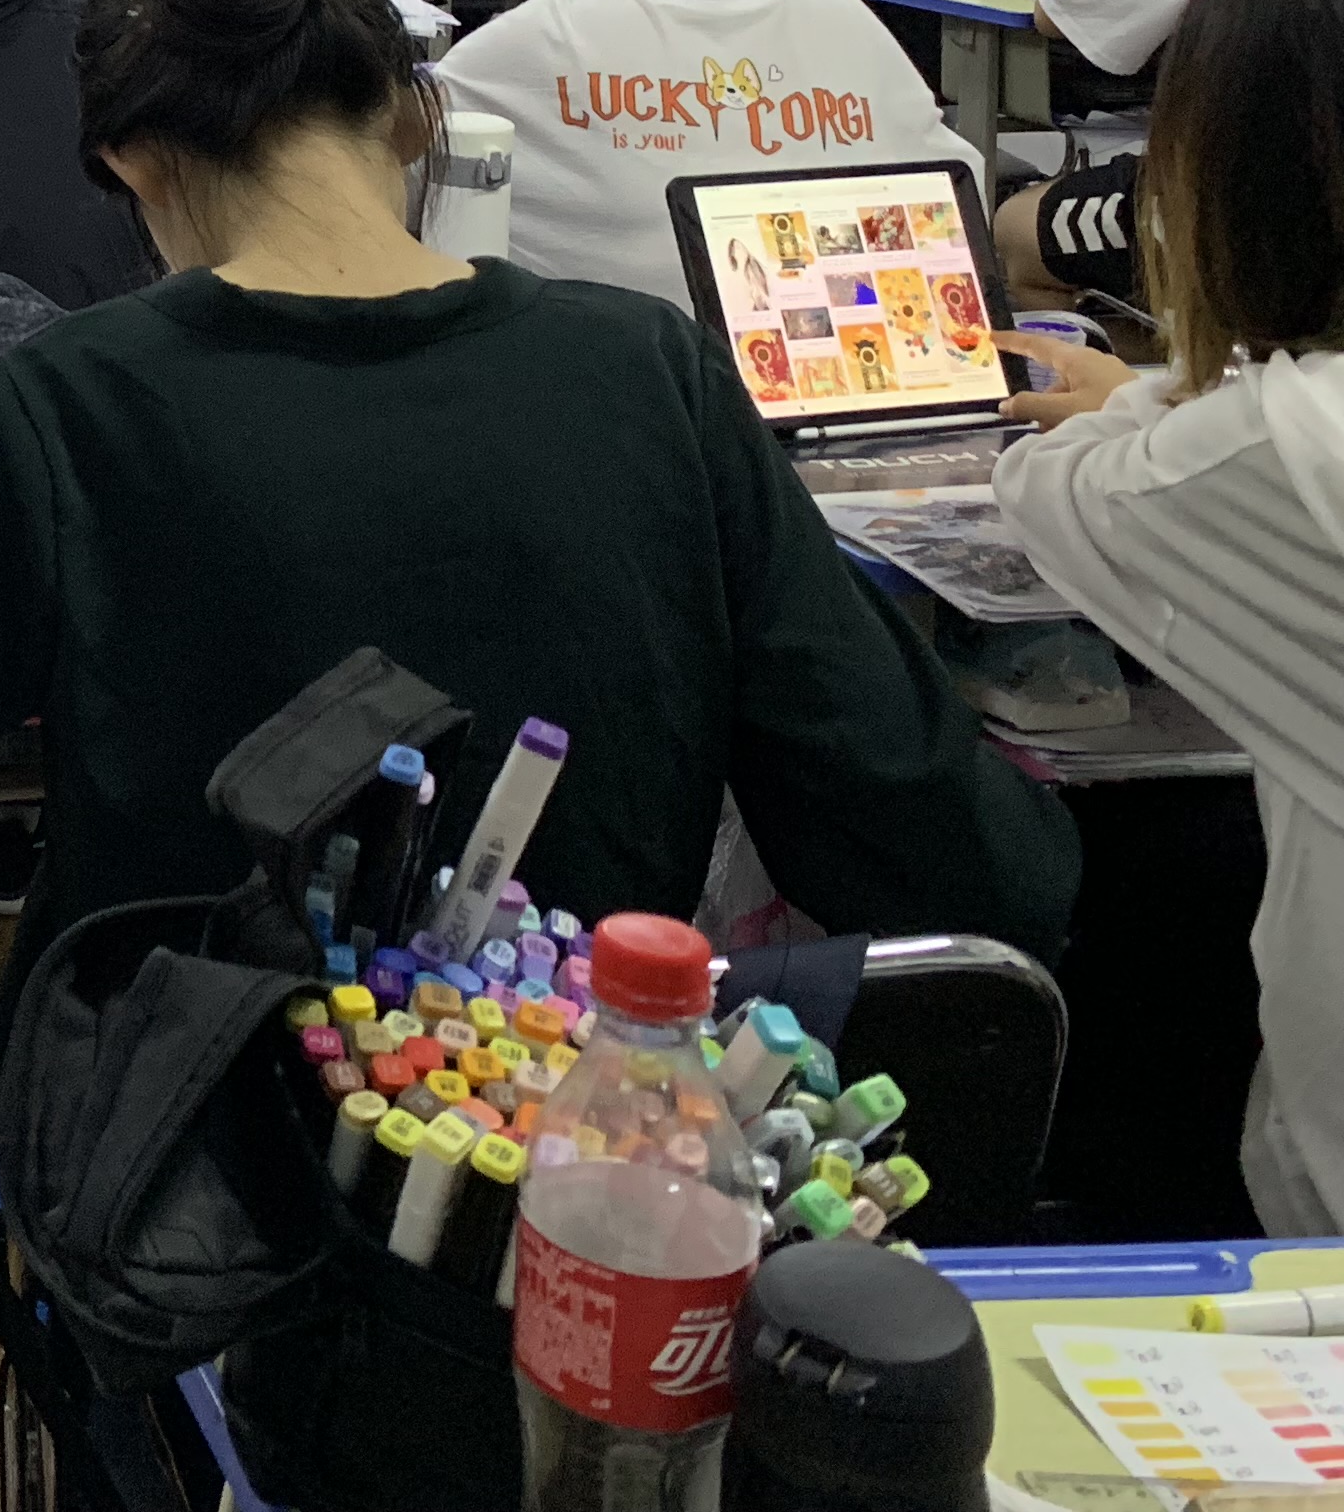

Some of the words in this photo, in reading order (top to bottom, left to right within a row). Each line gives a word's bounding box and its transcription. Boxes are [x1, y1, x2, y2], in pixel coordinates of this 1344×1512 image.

[556, 71, 726, 142] LUCKY
[745, 87, 875, 156] CORGI
[611, 127, 631, 150] is
[634, 130, 688, 152] your
[808, 451, 980, 470] TOUCH
